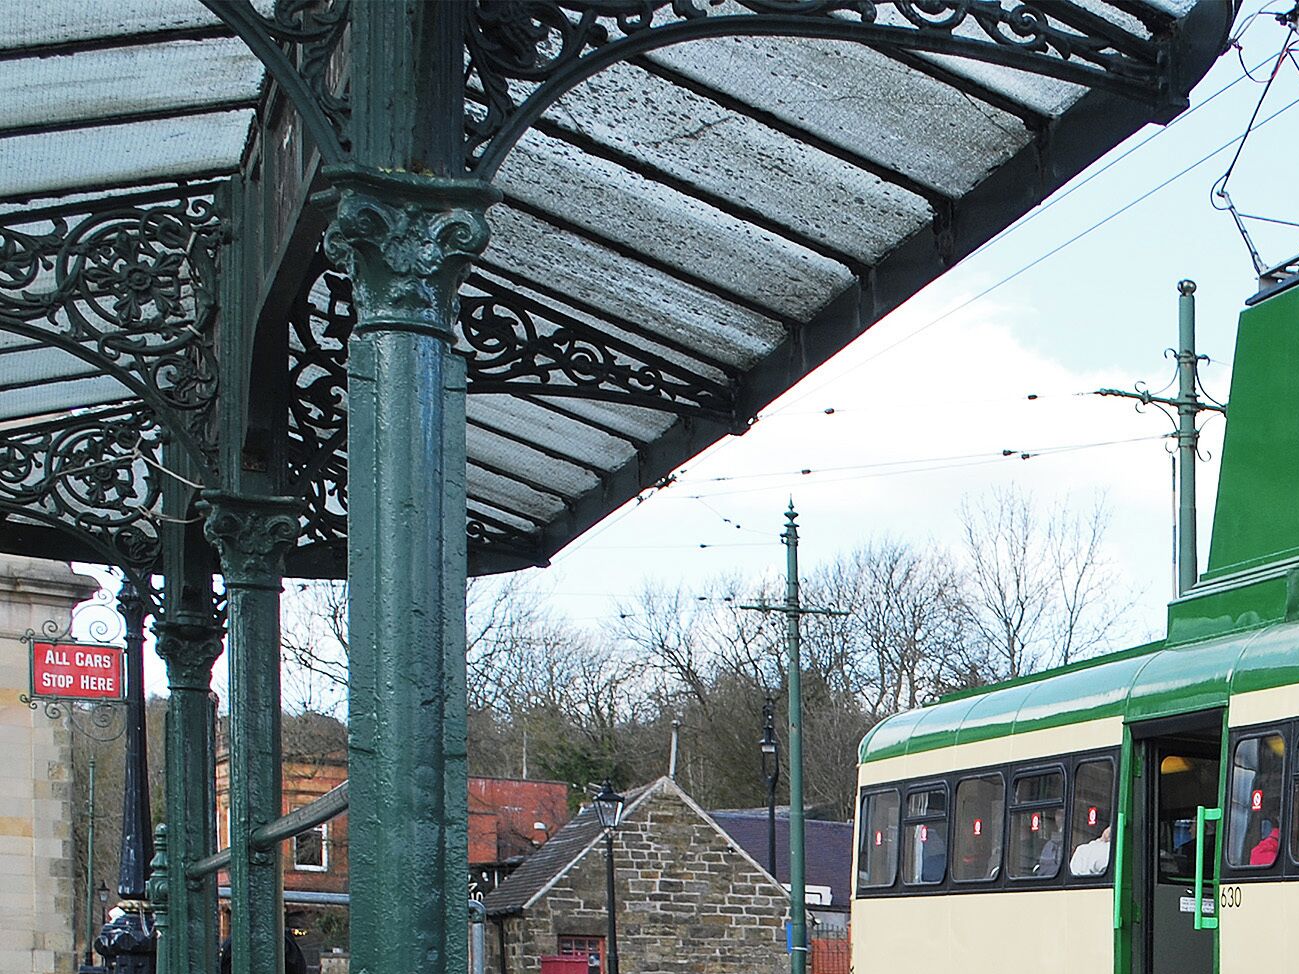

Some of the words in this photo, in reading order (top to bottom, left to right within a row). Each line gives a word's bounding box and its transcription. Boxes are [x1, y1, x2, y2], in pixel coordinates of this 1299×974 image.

[45, 650, 70, 666] ALL
[75, 651, 112, 668] CARS
[42, 672, 74, 688] STOP
[80, 675, 115, 691] HERE
[1220, 886, 1242, 908] 630
